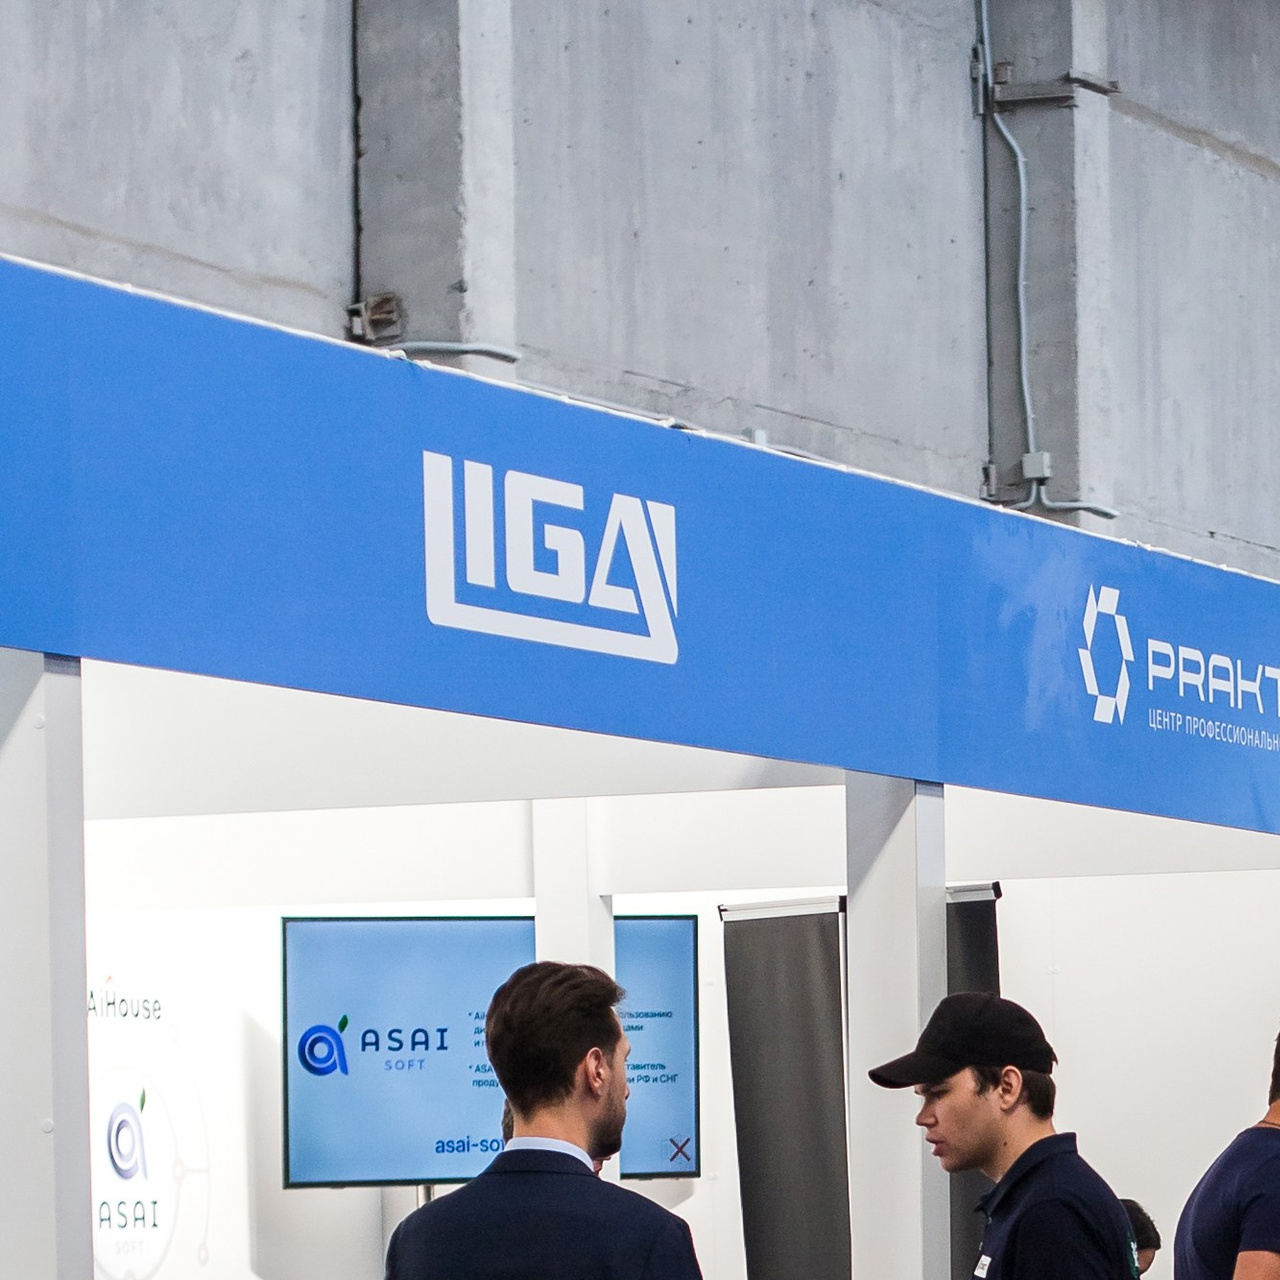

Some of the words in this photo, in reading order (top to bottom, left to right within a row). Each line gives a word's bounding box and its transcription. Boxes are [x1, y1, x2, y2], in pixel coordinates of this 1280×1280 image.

[422, 450, 678, 665] LIGA
[1148, 708, 1183, 732] ЦЕНТР
[87, 990, 162, 1020] AiHouse
[361, 1027, 448, 1052] ASAI
[384, 1060, 426, 1072] SOFT
[636, 1075, 650, 1083] РФ
[660, 1074, 678, 1083] СНГ
[99, 1201, 159, 1229] ASAI
